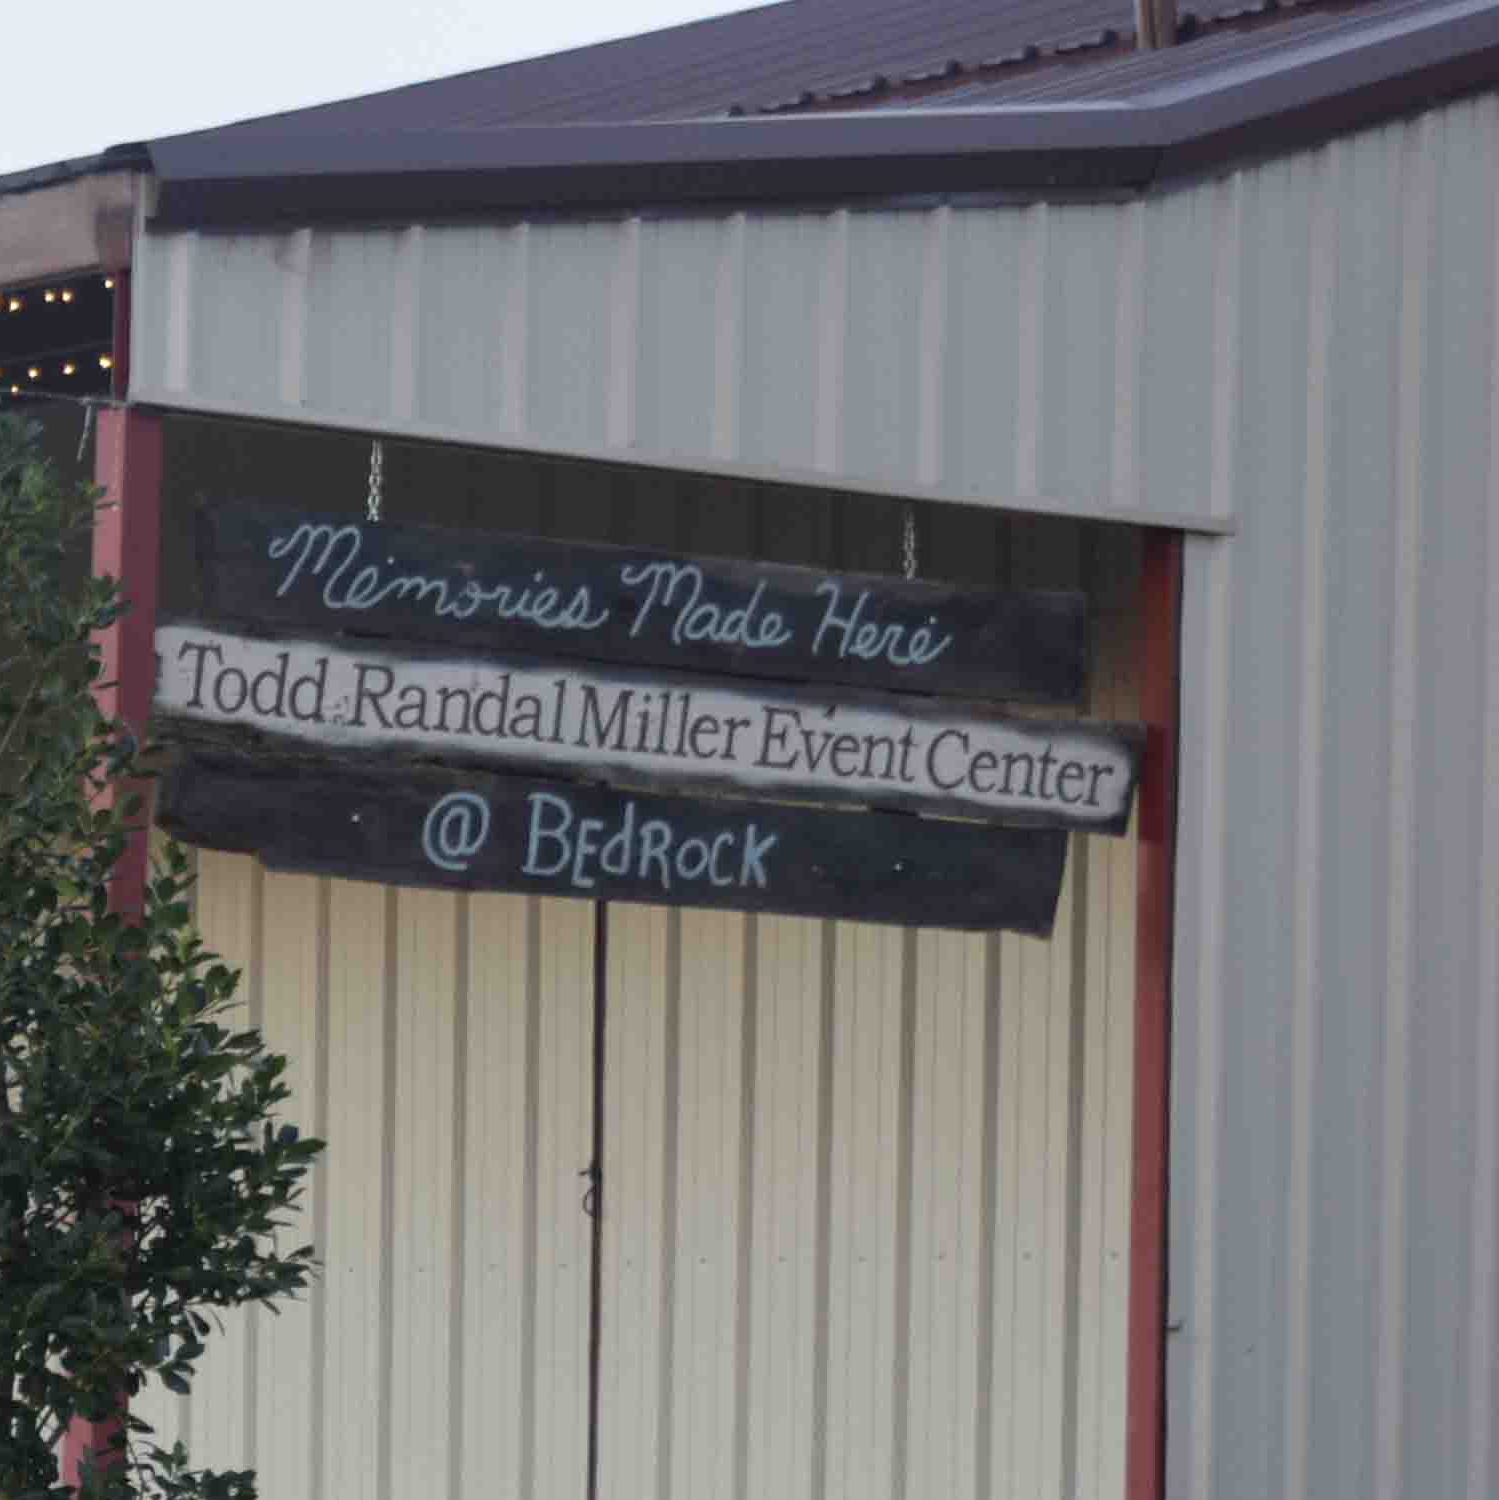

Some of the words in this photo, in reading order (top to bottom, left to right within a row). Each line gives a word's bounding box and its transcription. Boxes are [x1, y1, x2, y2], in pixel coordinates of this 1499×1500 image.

[269, 524, 609, 630] Memories
[621, 562, 793, 649] Made
[811, 578, 954, 665] Here
[349, 663, 565, 744] Randal
[574, 685, 752, 763] Miller
[757, 707, 920, 782] Event
[923, 729, 1116, 807] Center
[421, 792, 491, 868] @
